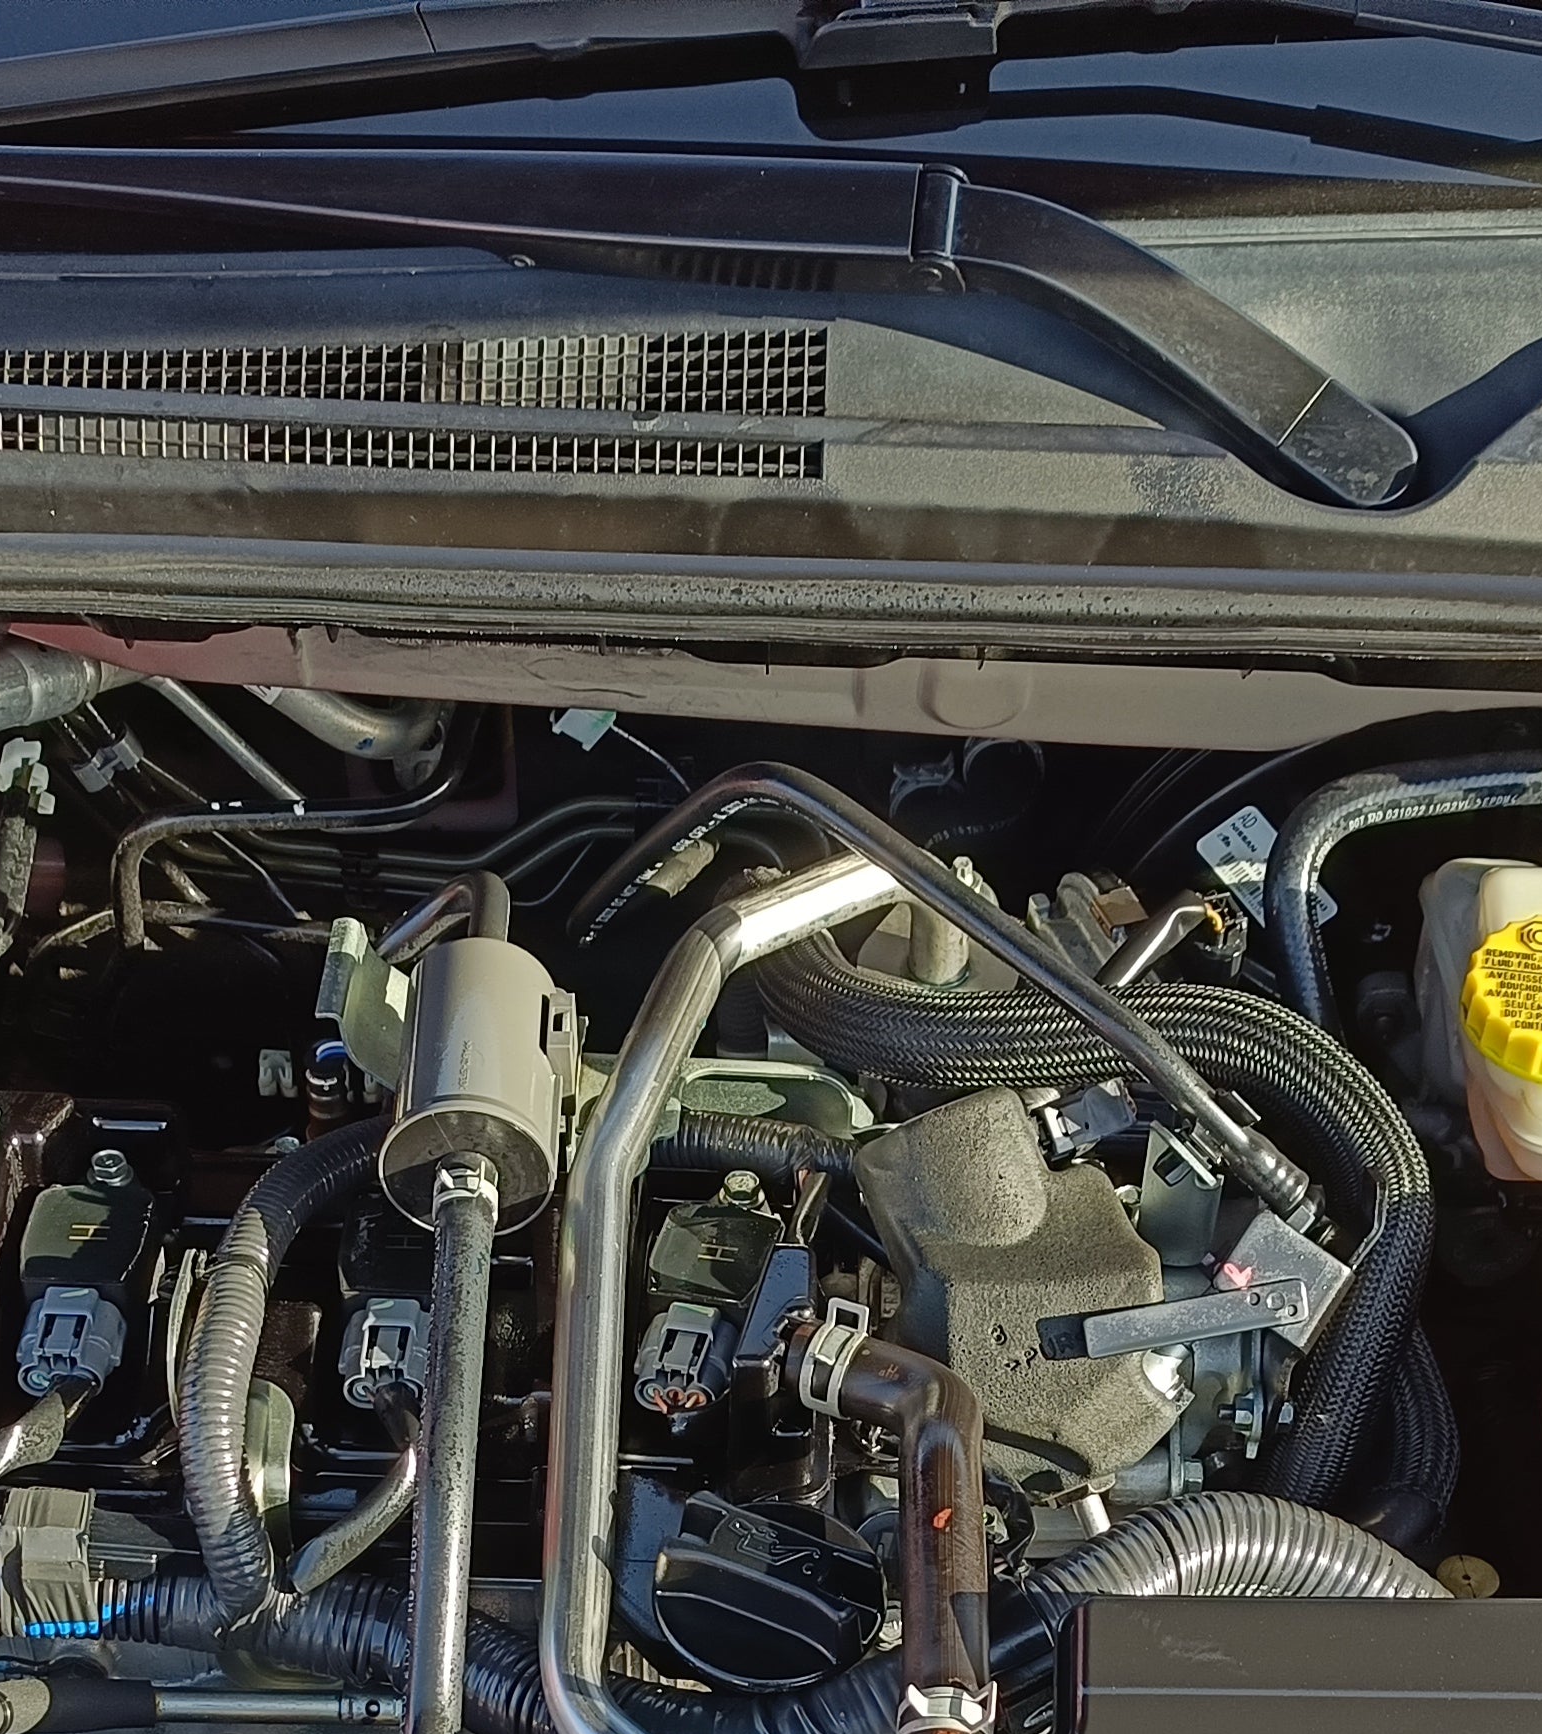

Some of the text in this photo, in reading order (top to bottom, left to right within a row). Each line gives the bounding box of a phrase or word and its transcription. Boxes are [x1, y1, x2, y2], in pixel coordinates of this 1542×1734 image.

[1483, 957, 1514, 967] FLUID
[1486, 988, 1521, 999] AVANT
[1525, 993, 1540, 1001] DE
[1503, 1009, 1522, 1018] DOT
